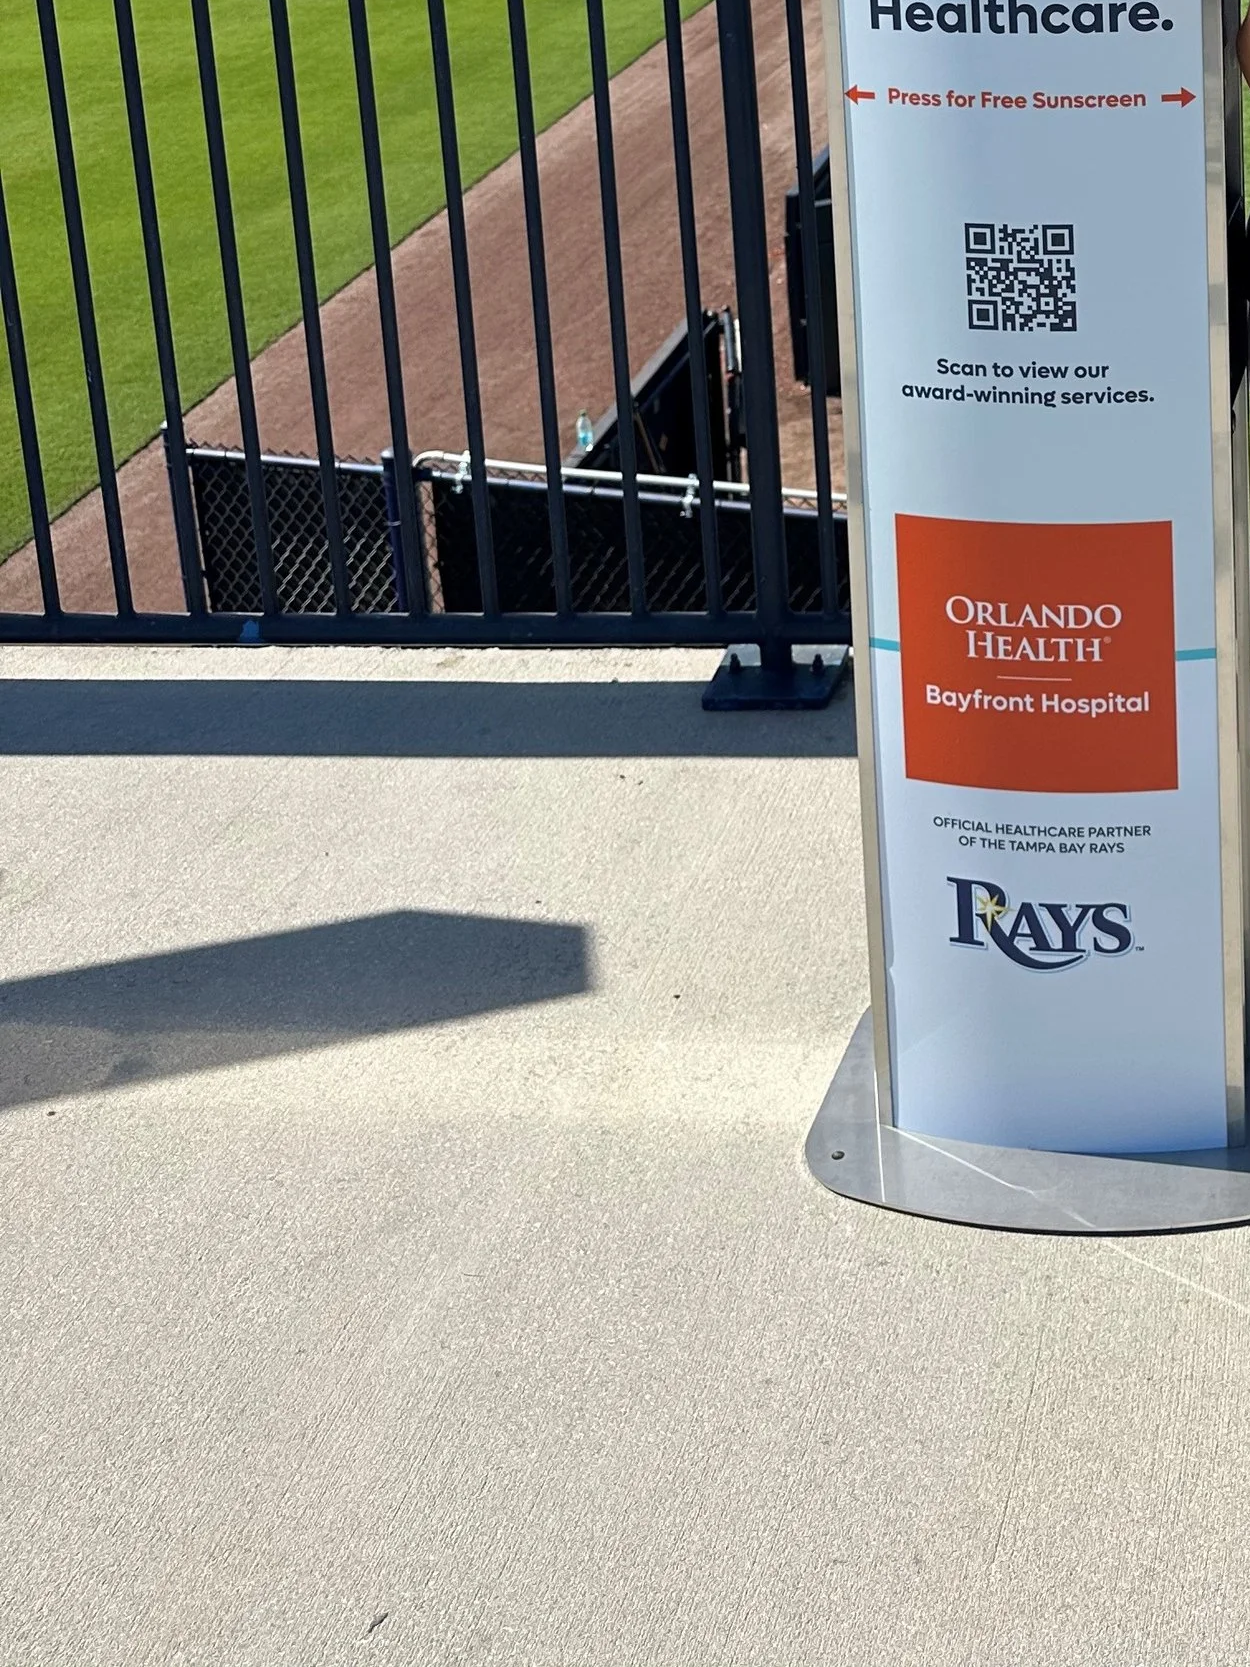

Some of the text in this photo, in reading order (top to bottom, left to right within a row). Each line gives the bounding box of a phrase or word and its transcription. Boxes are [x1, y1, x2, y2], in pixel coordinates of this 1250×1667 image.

[888, 87, 1147, 109] Press for Free Sunscreen
[936, 358, 1110, 379] Scan to view our
[901, 384, 1155, 409] award-winning services.
[945, 595, 1122, 629] ORLANDO
[925, 684, 1150, 718] Bayfront Hospital
[933, 816, 1152, 838] OFFICIAL HEALTHCARE PARTNER
[958, 835, 1125, 854] OF THE TAMPA BAY RAYS
